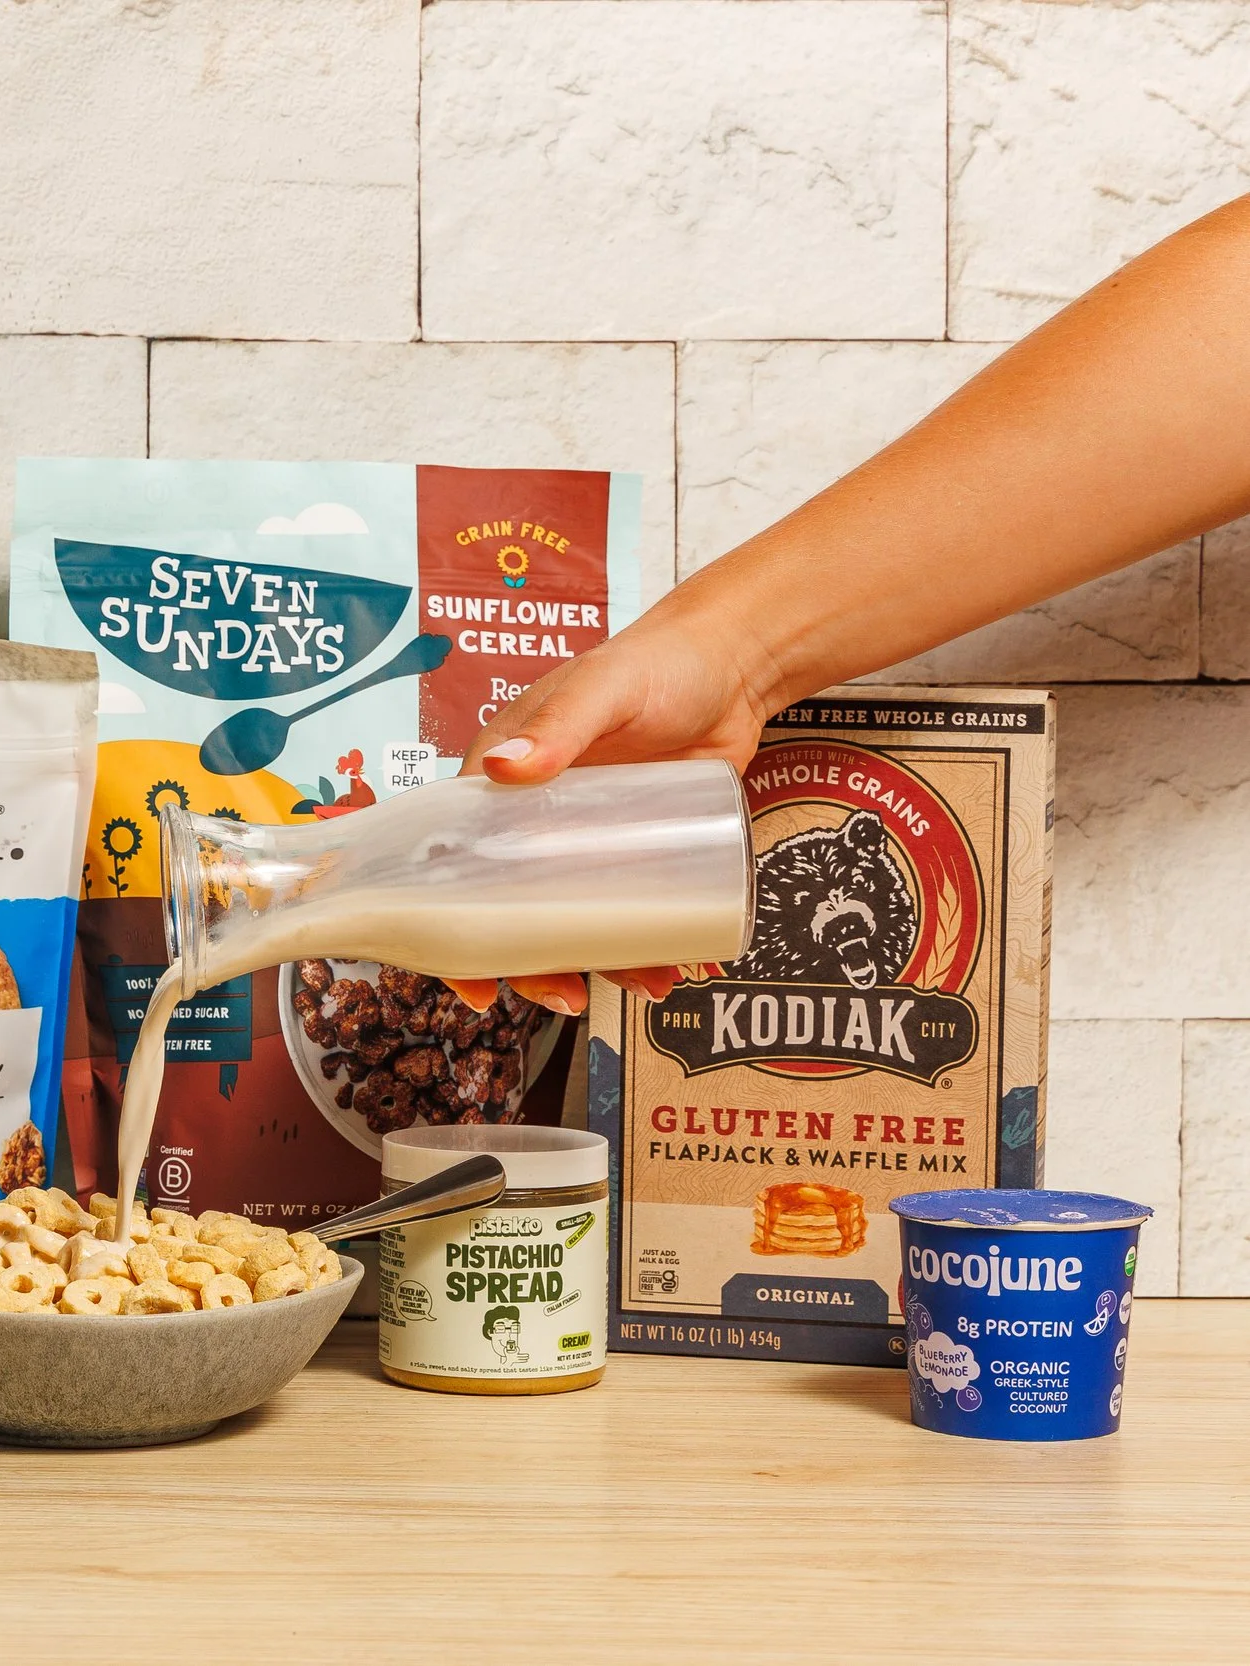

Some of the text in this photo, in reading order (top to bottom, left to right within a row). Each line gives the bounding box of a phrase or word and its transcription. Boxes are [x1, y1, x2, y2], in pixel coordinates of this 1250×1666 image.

[455, 520, 572, 555] GRAIN FREE
[150, 555, 319, 616] SEVEN
[427, 594, 601, 629] SUNFLOWER
[99, 596, 345, 674] SUNDAYS
[458, 629, 575, 659] CEREAL
[776, 709, 1028, 727] TEN FREE WHOLE GRAINS
[392, 750, 429, 762] KEEP
[776, 750, 855, 765] CRAFTED WITH
[404, 763, 417, 775] IT
[749, 765, 931, 838] WHOLE GRAINS
[126, 978, 153, 990] 100%
[127, 1009, 144, 1020] NO
[195, 1007, 229, 1019] SUGAR
[662, 1012, 701, 1029] PARK
[710, 991, 916, 1063] KODIAK
[920, 1021, 956, 1039] CITY
[166, 1039, 212, 1051] TEN FREE
[650, 1105, 966, 1146] GLUTEN FREE
[160, 1145, 193, 1156] Certified
[649, 1141, 967, 1173] FLAPJACK & WAFFLE MIX
[243, 1203, 347, 1216] NET WT 8 OZ
[469, 1216, 543, 1241] pistakio
[446, 1243, 564, 1269] PISTACHIO
[908, 1245, 1083, 1296] cocojune
[446, 1271, 564, 1303] SPREAD
[755, 1287, 855, 1306] ORIGINAL
[620, 1323, 643, 1339] NET
[647, 1325, 666, 1340] WT
[670, 1326, 684, 1341] 16
[688, 1327, 705, 1342] OZ
[726, 1327, 745, 1347] lb)
[749, 1330, 781, 1350] 454g
[957, 1317, 1073, 1338] 8g PROTEIN
[562, 1334, 591, 1348] CREAMY
[918, 1344, 968, 1364] BLUEBERRY
[919, 1358, 969, 1377] LEMONADE
[989, 1360, 1070, 1375] ORGANIC
[994, 1377, 1069, 1388] GREEK-STYLE
[1009, 1391, 1068, 1401] CULTURED
[1009, 1403, 1068, 1413] COCONUT
